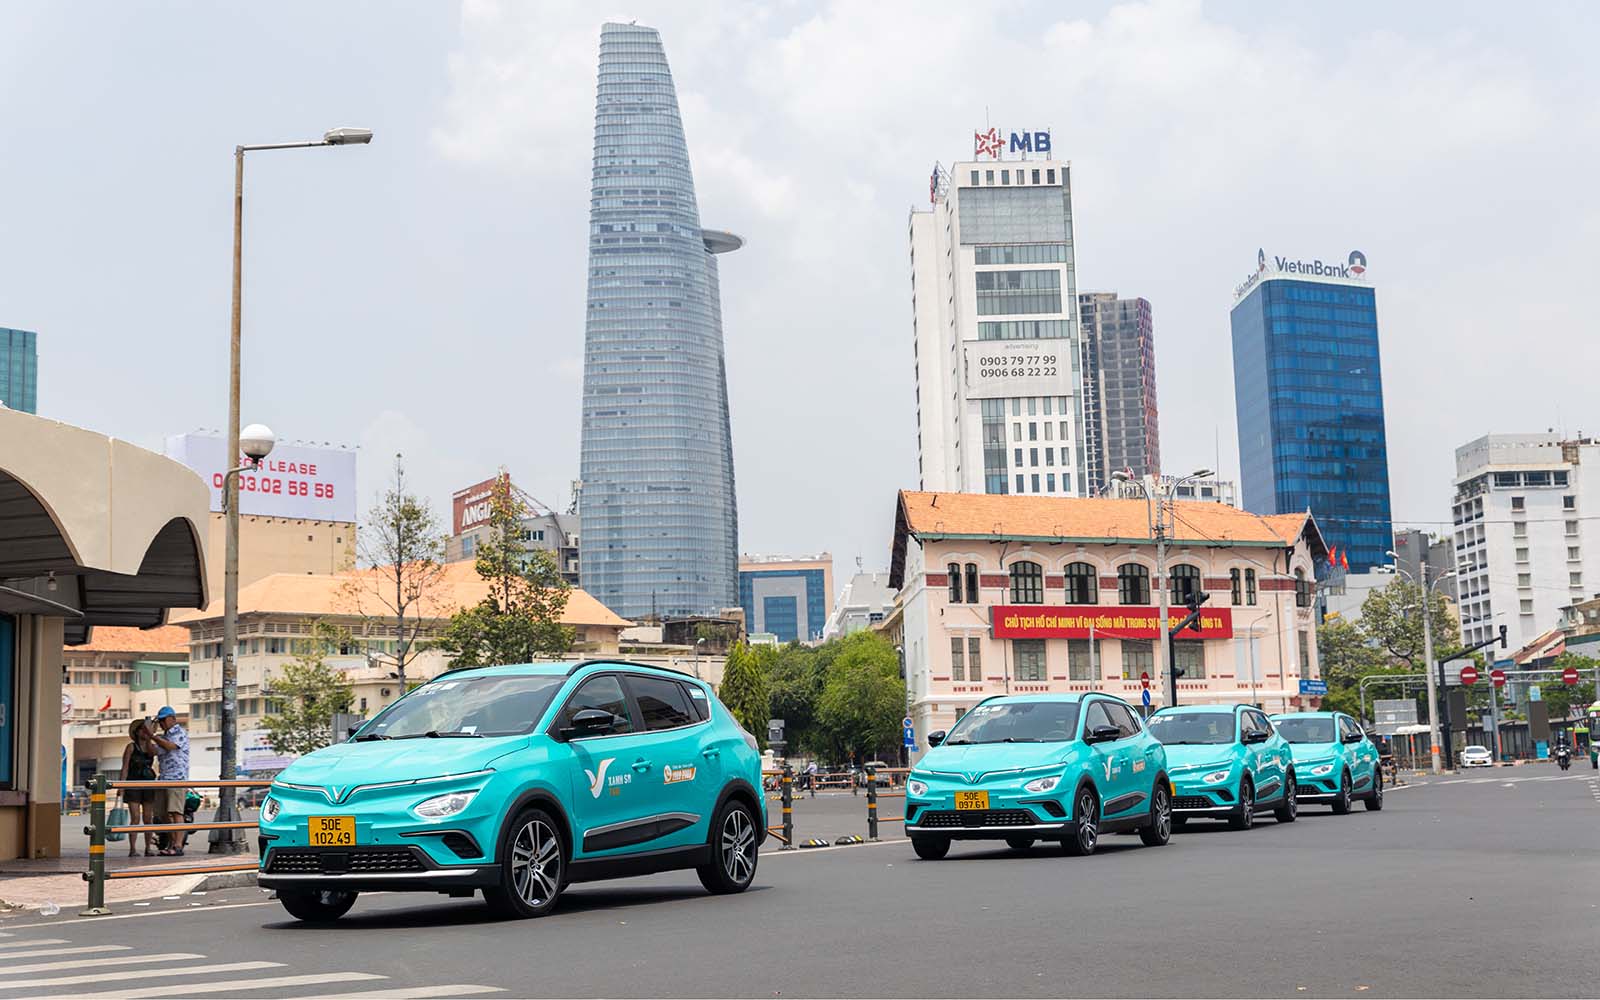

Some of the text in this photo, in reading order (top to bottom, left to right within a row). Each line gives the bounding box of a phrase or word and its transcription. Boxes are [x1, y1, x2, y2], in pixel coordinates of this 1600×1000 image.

[1010, 132, 1051, 153] MB
[1275, 256, 1349, 278] VietinBank
[980, 355, 1057, 366] 0903 79 77 99
[980, 367, 1057, 378] 0906 68 22 22
[239, 457, 317, 476] OR LEASE
[213, 473, 334, 499] 003.02 58 58
[1005, 614, 1019, 628] CHỦ
[1020, 617, 1035, 630] TỊCH
[1046, 615, 1057, 628] CHÍ
[1058, 617, 1075, 628] MINH
[1126, 617, 1147, 628] TRONG
[1214, 617, 1222, 628] TA
[964, 792, 979, 801] 50E
[959, 800, 985, 809] 097.61
[321, 818, 341, 831] 50E
[314, 832, 351, 845] 102.49
